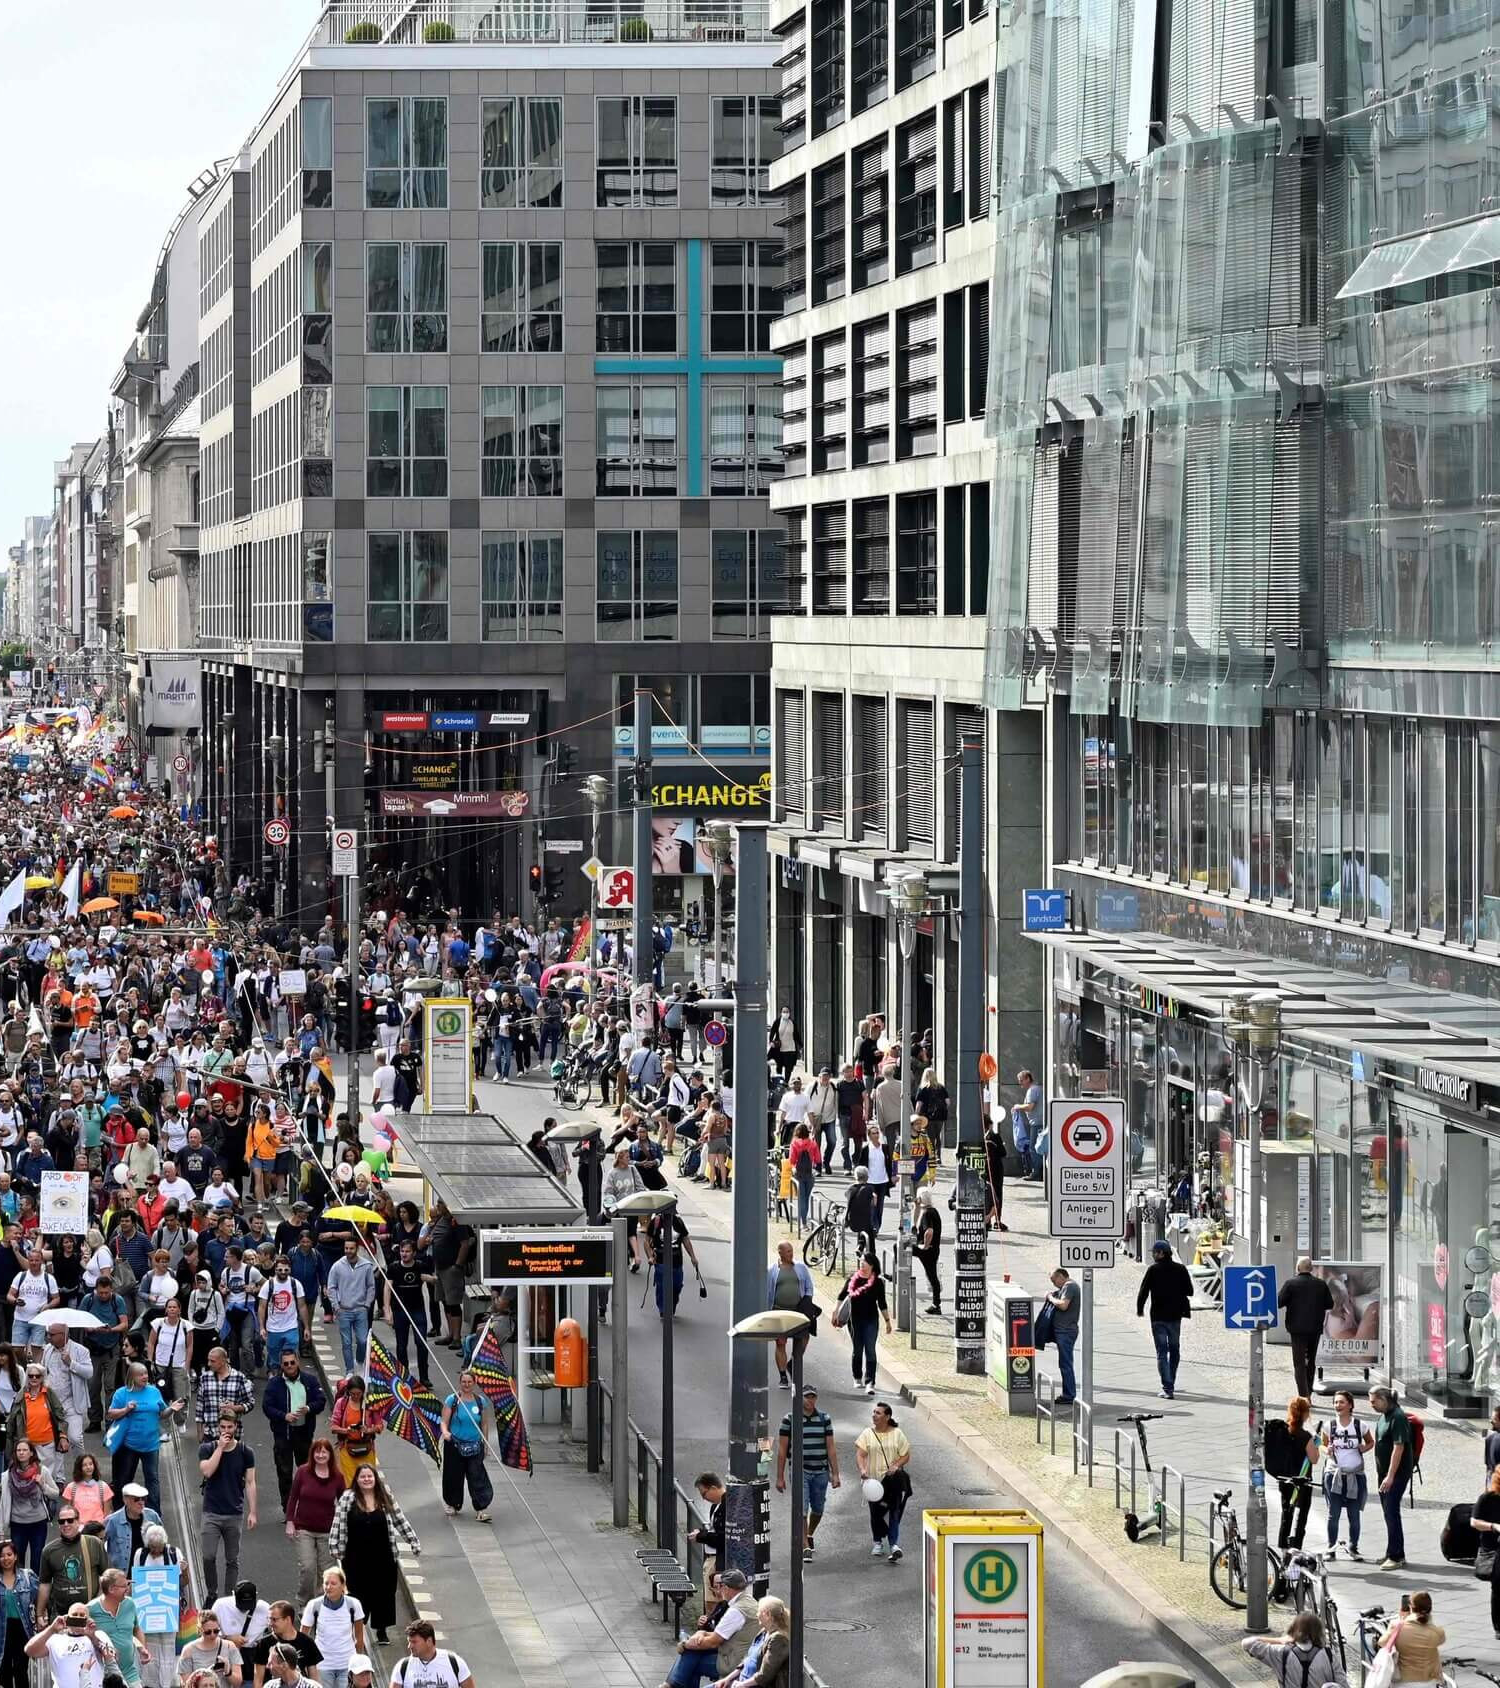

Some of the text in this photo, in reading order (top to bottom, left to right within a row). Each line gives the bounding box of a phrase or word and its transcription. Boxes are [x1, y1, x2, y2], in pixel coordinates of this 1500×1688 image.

[157, 692, 196, 700] MARITIM
[453, 794, 489, 803] Mmmh!
[1028, 914, 1062, 923] randstad
[1063, 1170, 1111, 1180] Diesel bis
[1065, 1183, 1109, 1192] Euro 5/V
[1066, 1203, 1108, 1215] Anlieger
[1079, 1216, 1096, 1225] frei
[1065, 1246, 1109, 1261] 100 m
[1246, 1282, 1265, 1314] P
[1322, 1340, 1369, 1350] FREEDOM
[978, 1562, 1004, 1591] H
[961, 1622, 972, 1630] M1
[962, 1646, 970, 1654] 12
